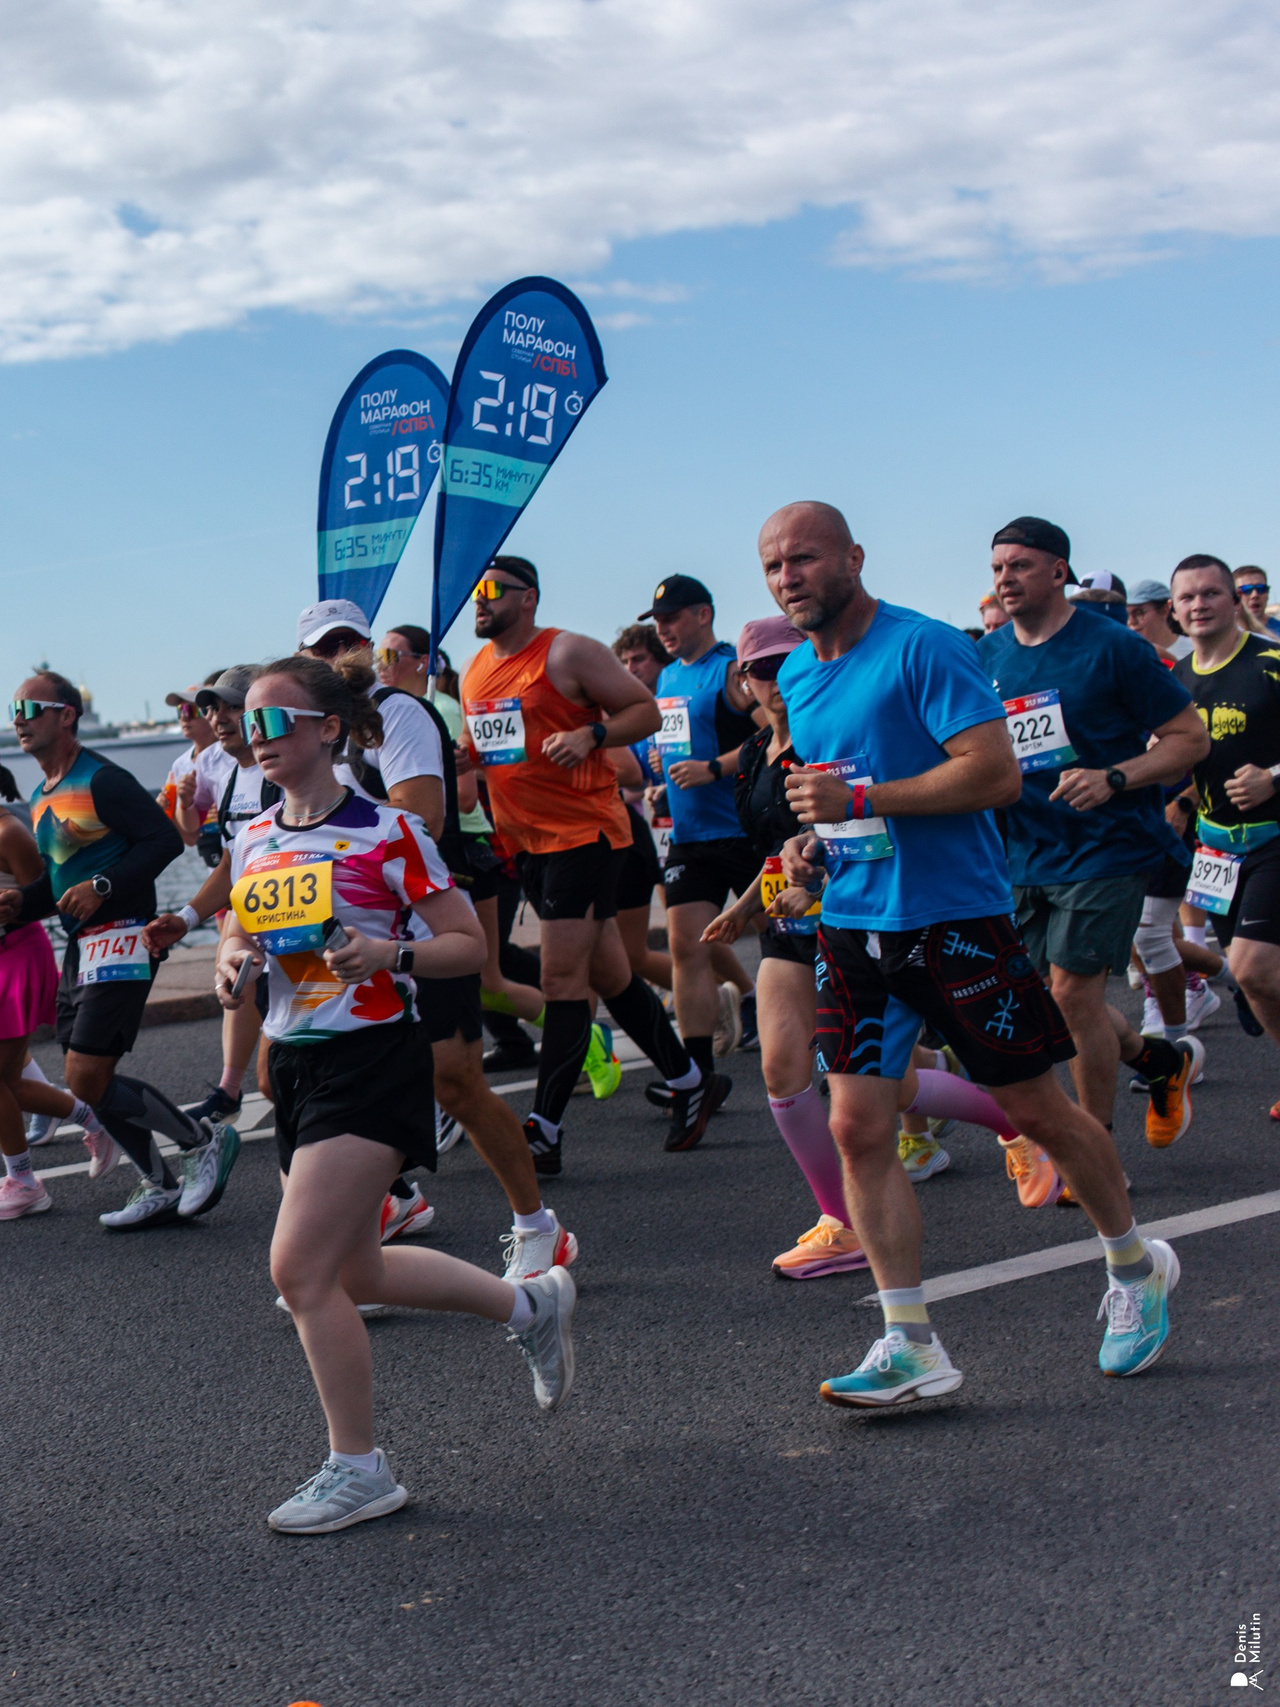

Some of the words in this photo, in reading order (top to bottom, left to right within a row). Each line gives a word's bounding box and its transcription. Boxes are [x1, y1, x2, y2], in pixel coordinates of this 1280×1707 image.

[504, 310, 546, 334] ПОЛУ
[502, 327, 577, 361] МАРАФОН
[360, 388, 399, 409] ПОЛУ
[360, 398, 431, 425] МАРАФОН
[472, 369, 558, 446] 2:19
[344, 443, 421, 511] 2:19
[449, 458, 493, 489] 6:35
[494, 479, 511, 493] КМ
[334, 534, 369, 561] 6:35
[372, 543, 387, 556] КМ
[474, 716, 517, 740] 6094
[1194, 860, 1229, 887] 3971
[243, 872, 318, 914] 6313
[256, 909, 307, 926] КРИСТИНА
[86, 934, 138, 962] 7747
[951, 975, 999, 999] HARDCORE
